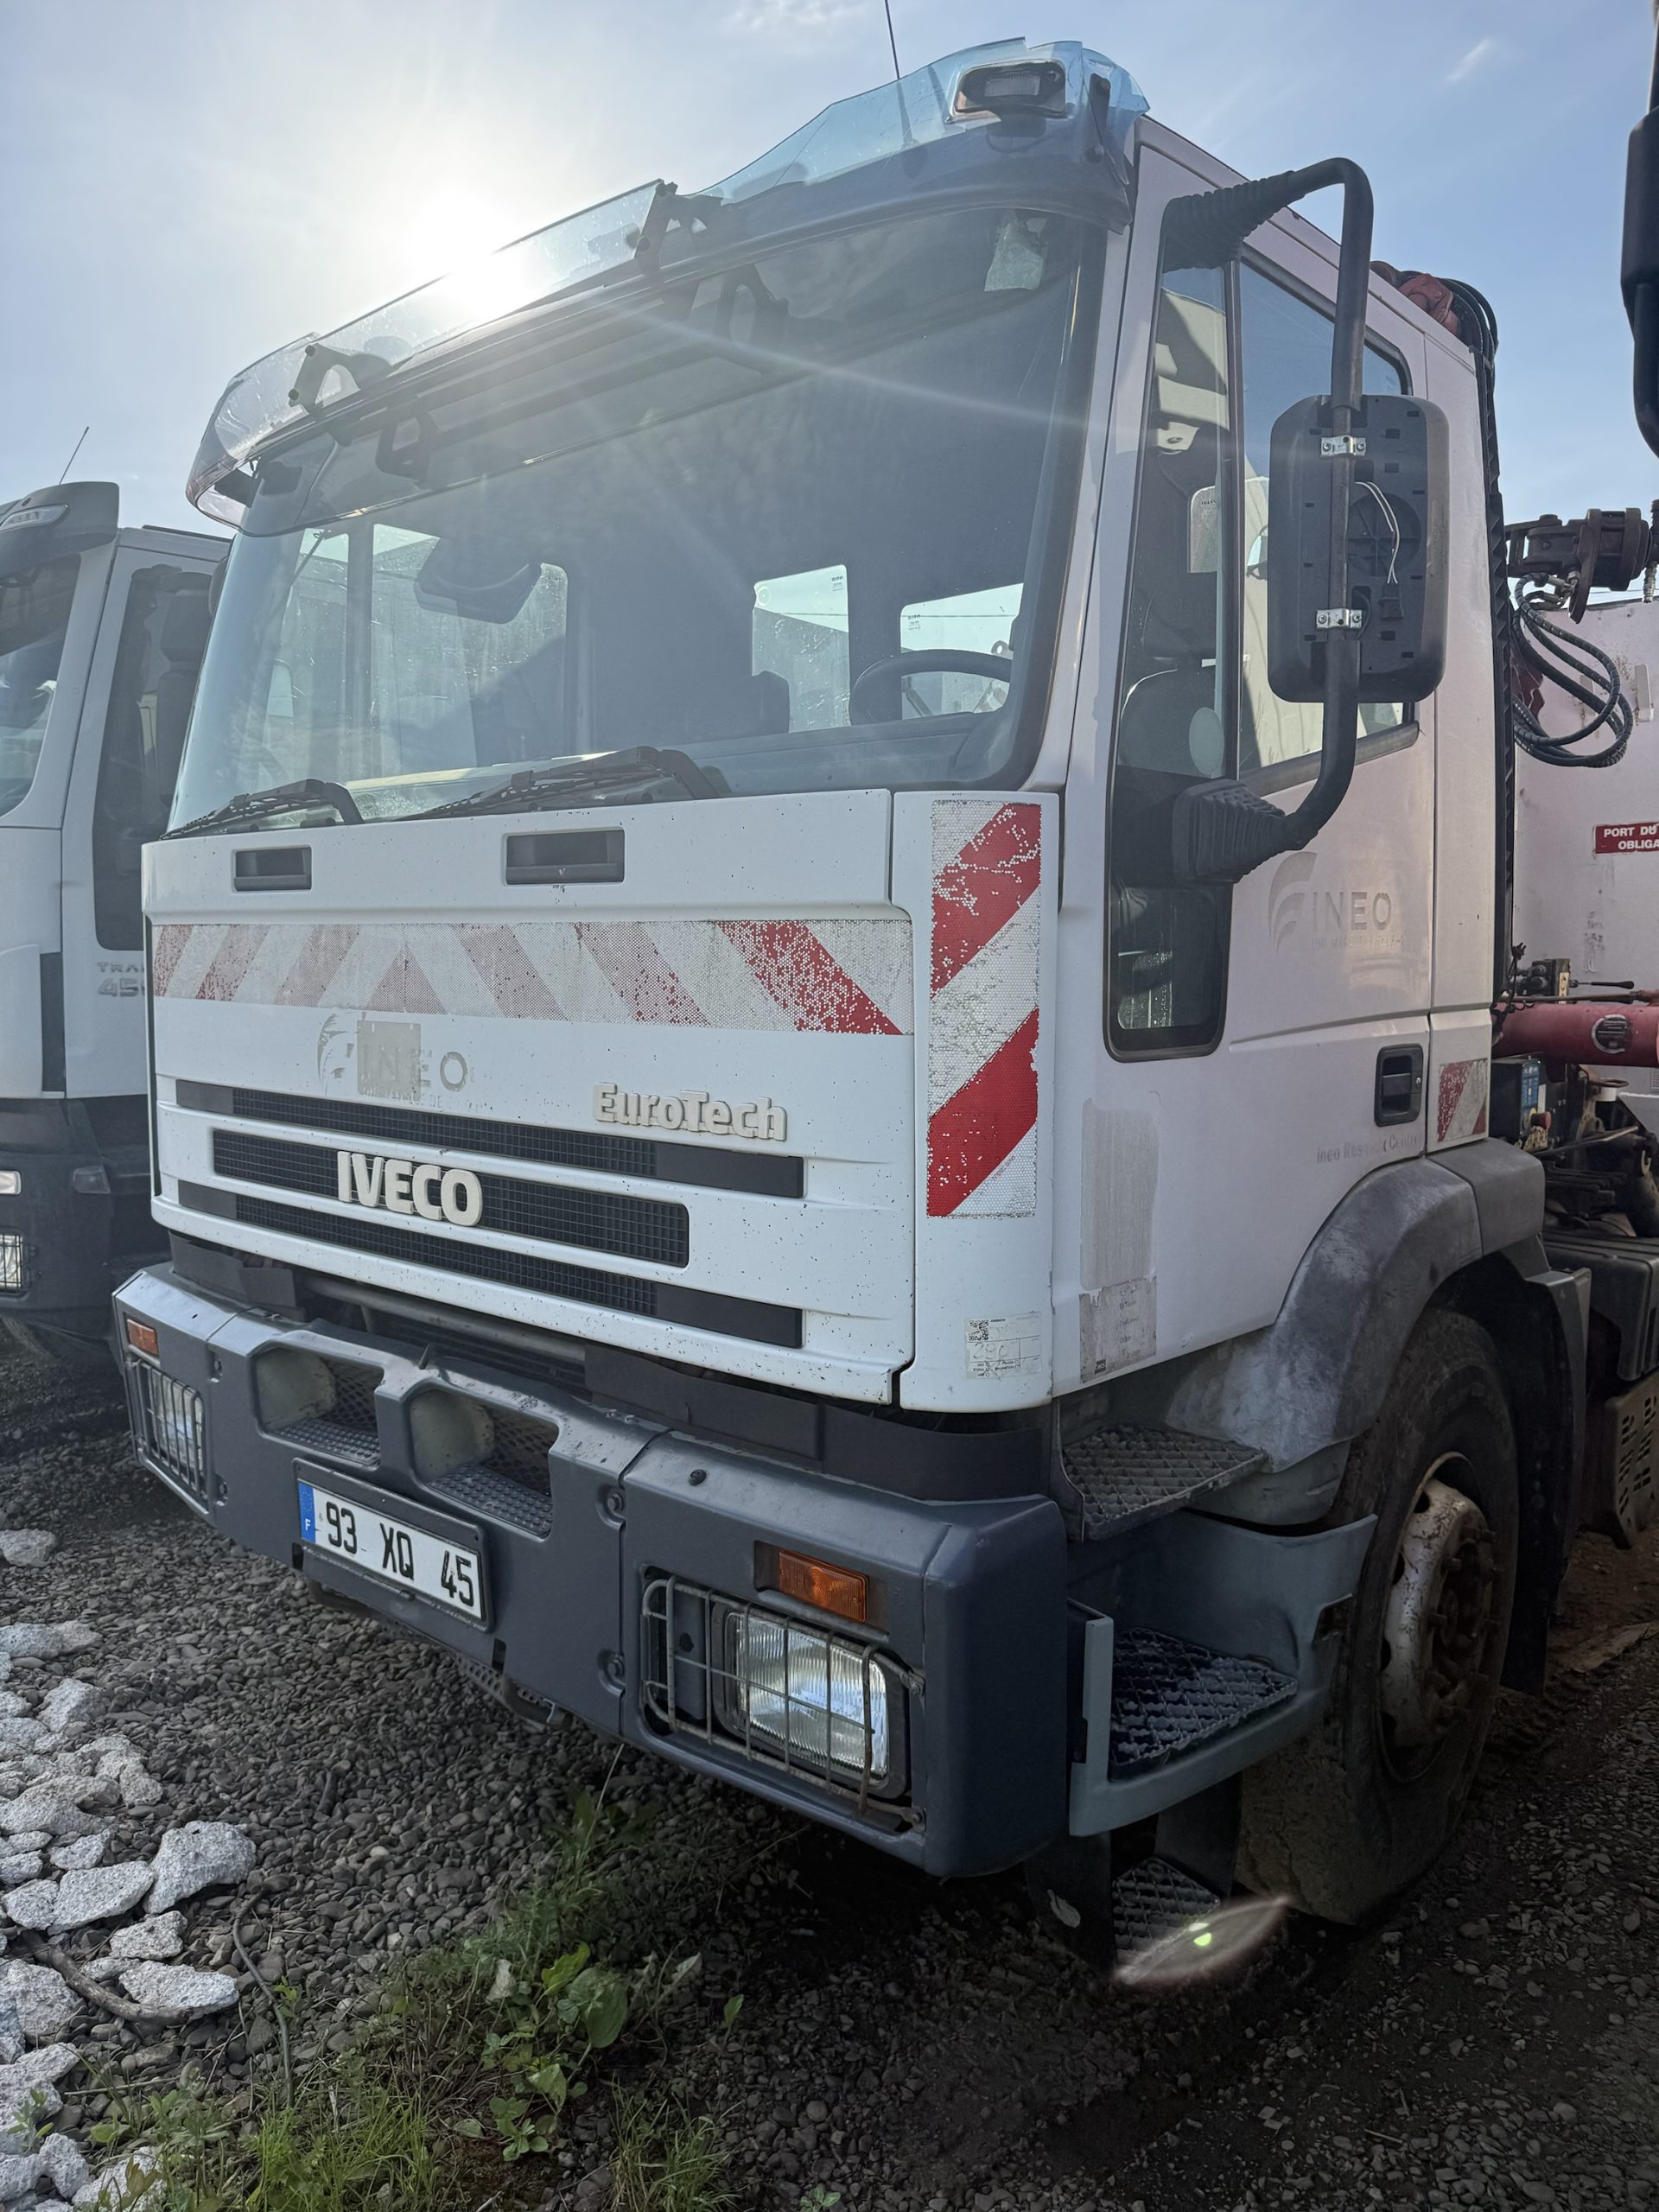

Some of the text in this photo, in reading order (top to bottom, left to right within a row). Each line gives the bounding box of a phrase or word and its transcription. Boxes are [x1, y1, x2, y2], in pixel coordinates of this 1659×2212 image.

[1604, 825, 1657, 837] PORT DU
[1313, 892, 1391, 931] INEO
[593, 1082, 788, 1141] EuroTech
[337, 1150, 482, 1227] IVECO
[304, 1518, 312, 1531] F
[326, 1501, 358, 1555] 93
[379, 1522, 415, 1581] XQ
[441, 1550, 474, 1607] 45
